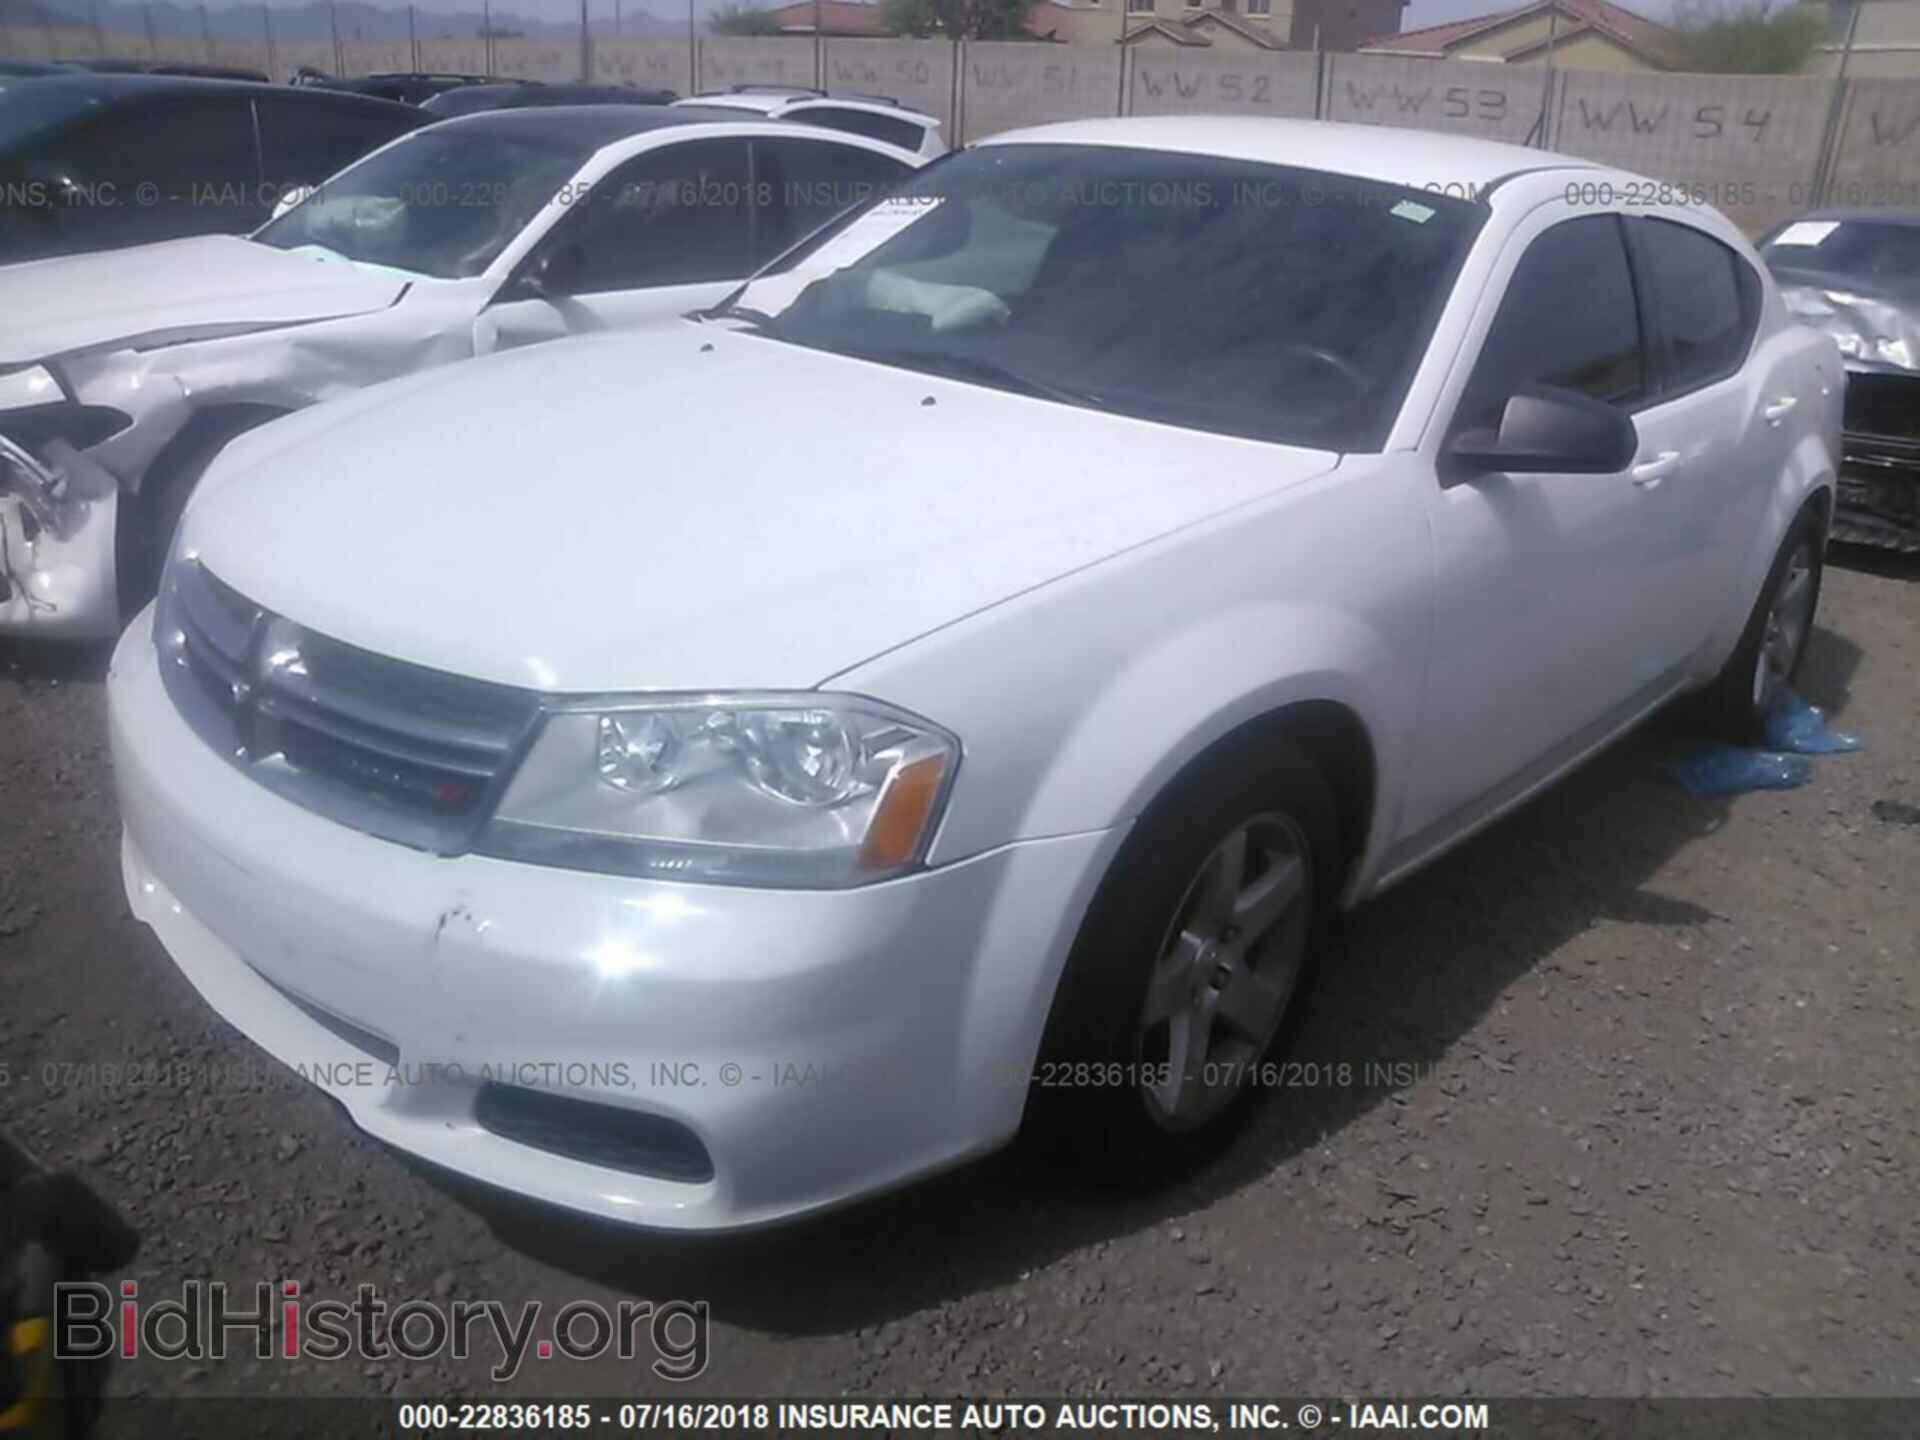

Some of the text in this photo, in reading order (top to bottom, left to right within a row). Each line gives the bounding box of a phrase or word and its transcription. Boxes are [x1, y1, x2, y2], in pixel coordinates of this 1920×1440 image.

[1142, 69, 1274, 104] WW 52
[1346, 80, 1509, 120] WW 53
[1578, 96, 1670, 136] WW
